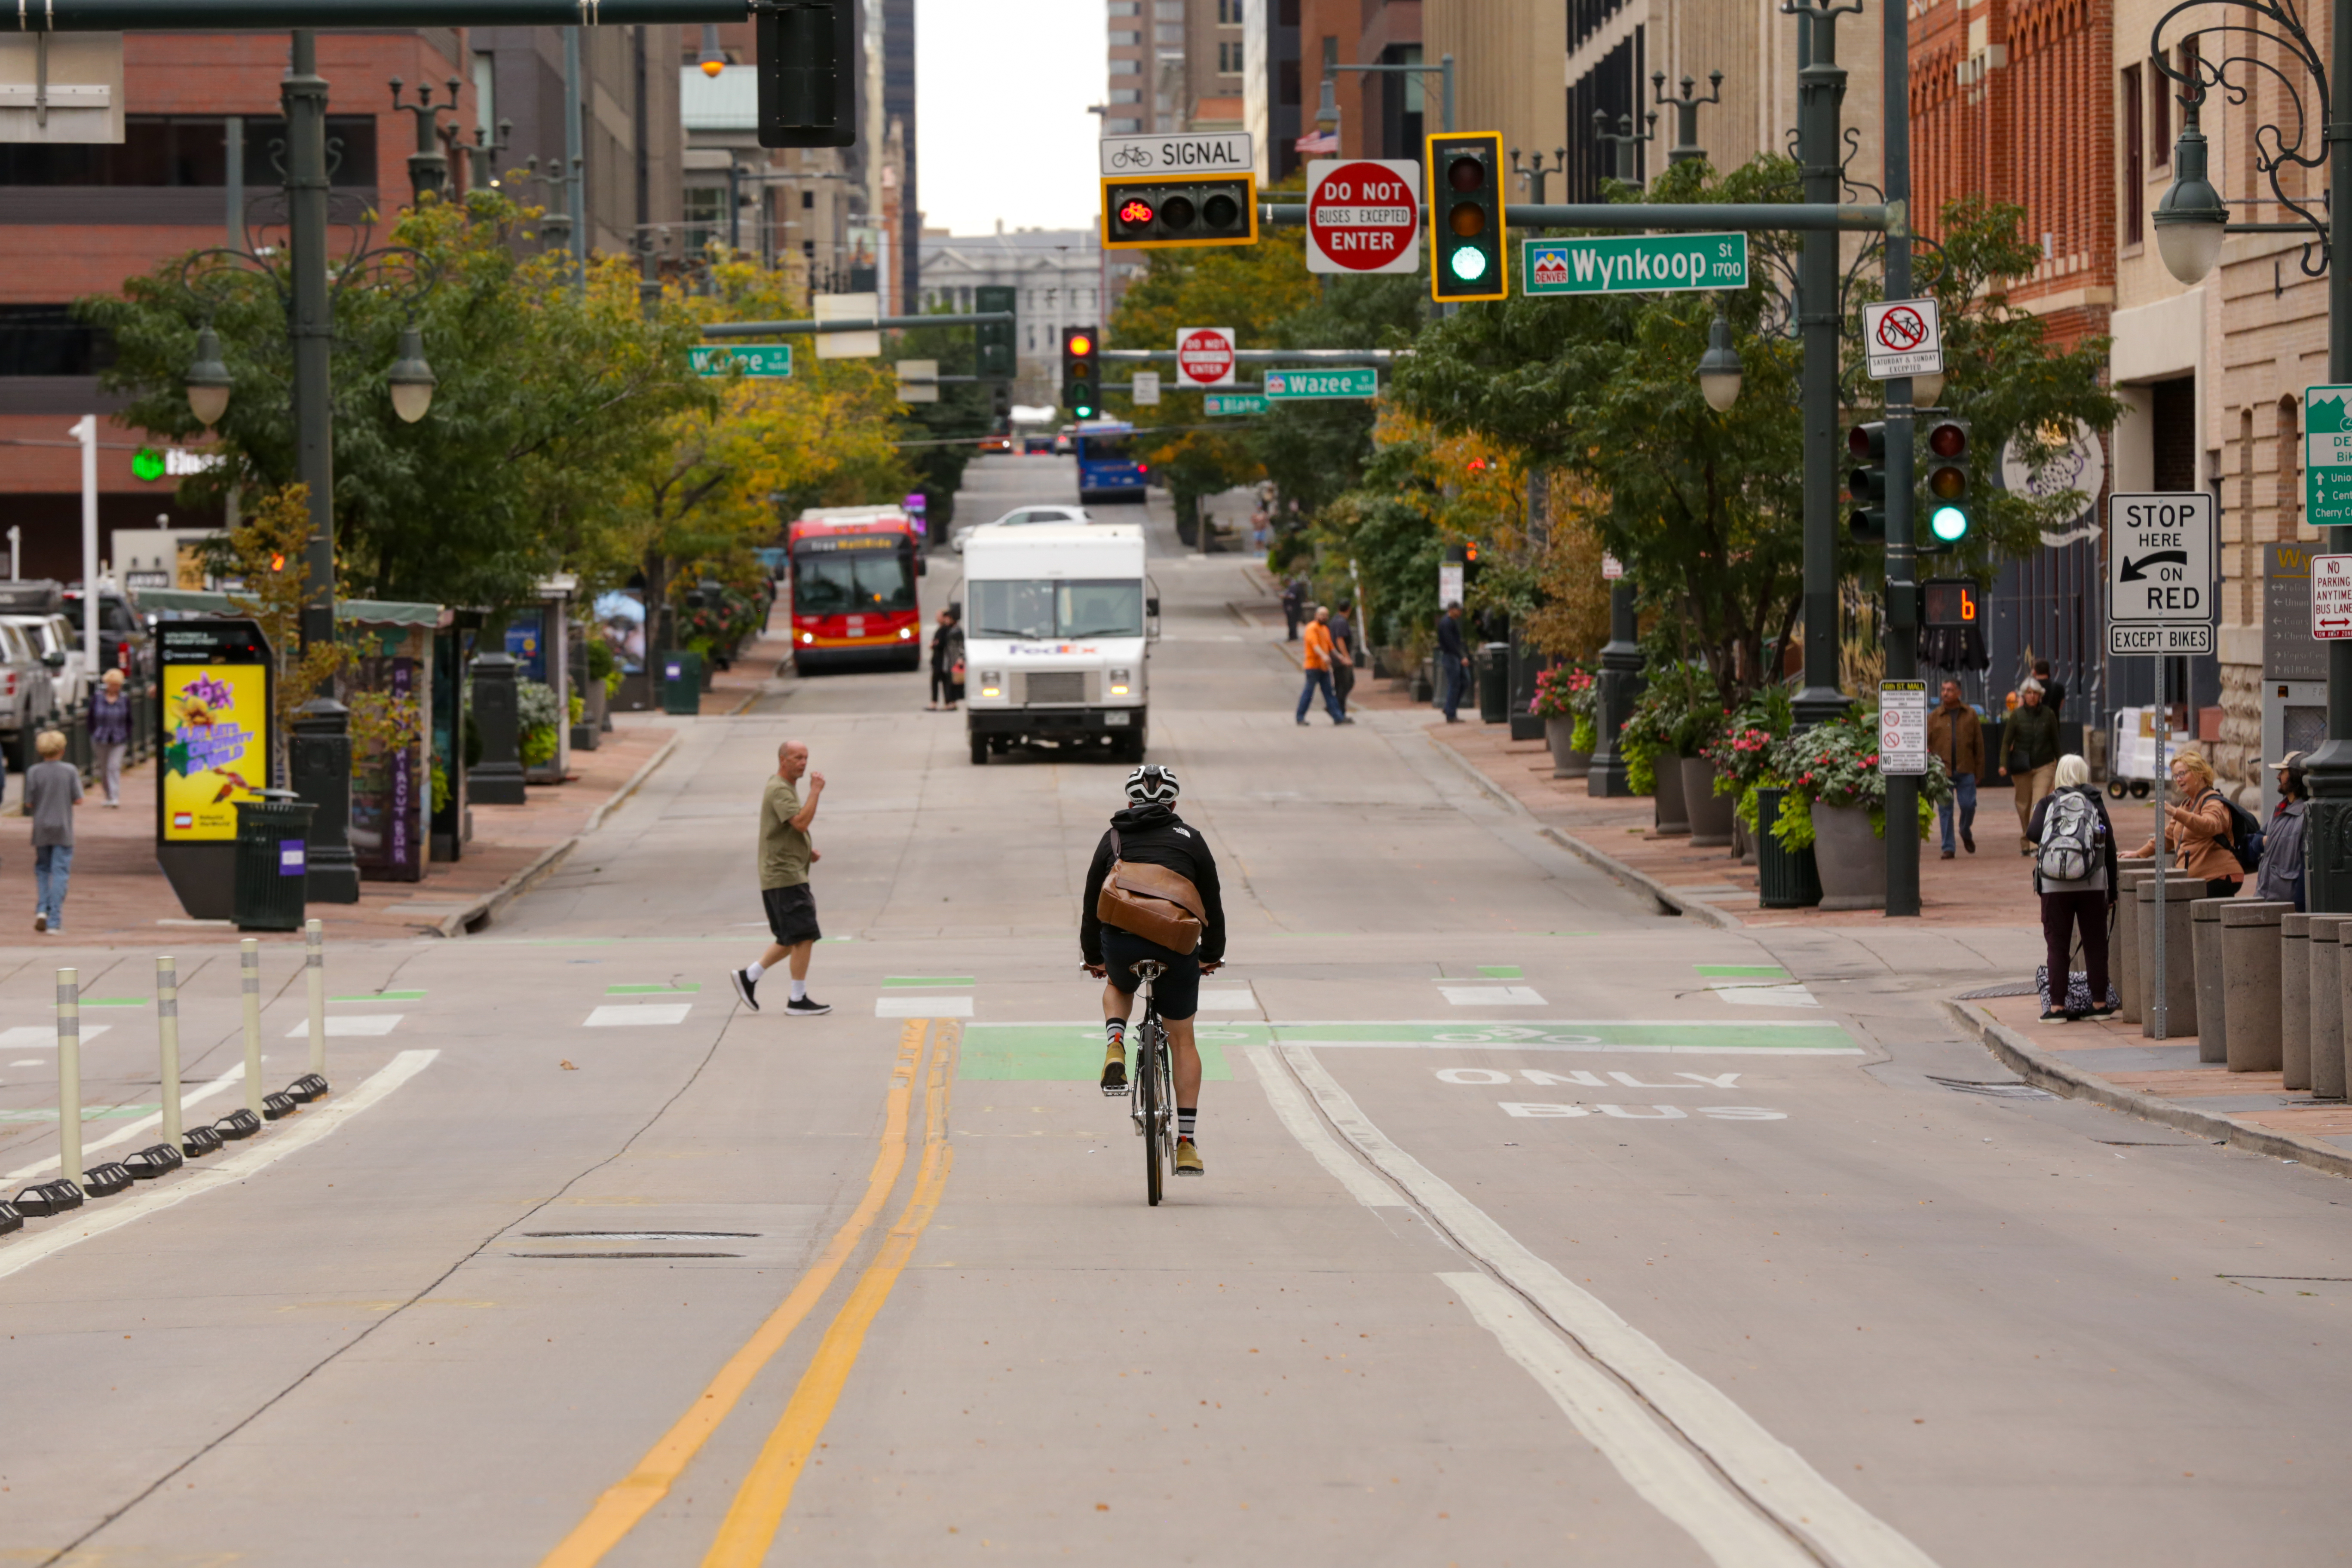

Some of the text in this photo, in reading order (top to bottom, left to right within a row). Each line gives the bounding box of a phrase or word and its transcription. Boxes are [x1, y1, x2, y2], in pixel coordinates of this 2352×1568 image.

[1162, 141, 1240, 165] SIGNAL
[1325, 182, 1403, 200] DO NOT
[1318, 208, 1408, 223] BUSES EXCEPTED
[1331, 232, 1394, 250] ENTER
[1719, 243, 1732, 257] St
[1571, 248, 1706, 290] Wynkoop
[1712, 262, 1741, 278] 1700
[1536, 272, 1567, 282] DENVER
[1185, 338, 1225, 349] DO NOT
[692, 352, 763, 372] Wee
[1873, 357, 1902, 366] SATURDAY
[1913, 354, 1936, 362] SUNDAY
[1189, 364, 1223, 375] ENTER
[1289, 375, 1352, 393] Wazee
[2334, 436, 2352, 447] DE
[2331, 473, 2352, 482] Unio
[2127, 505, 2195, 528] STOP
[2315, 507, 2352, 519] Cherry C
[2139, 533, 2182, 547] HERE
[2328, 561, 2340, 574] NO
[2160, 568, 2182, 582] ON
[2318, 576, 2350, 588] PARKING
[2148, 587, 2199, 609] RED
[2317, 590, 2352, 601] ANYTIME
[2316, 603, 2352, 614] BUS LANE
[2115, 631, 2206, 648] EXCEPT BIKES
[1010, 645, 1098, 654] FedEx
[1883, 756, 1891, 765] NO
[1435, 1067, 1743, 1088] ONLY
[1497, 1101, 1788, 1120] BUS
